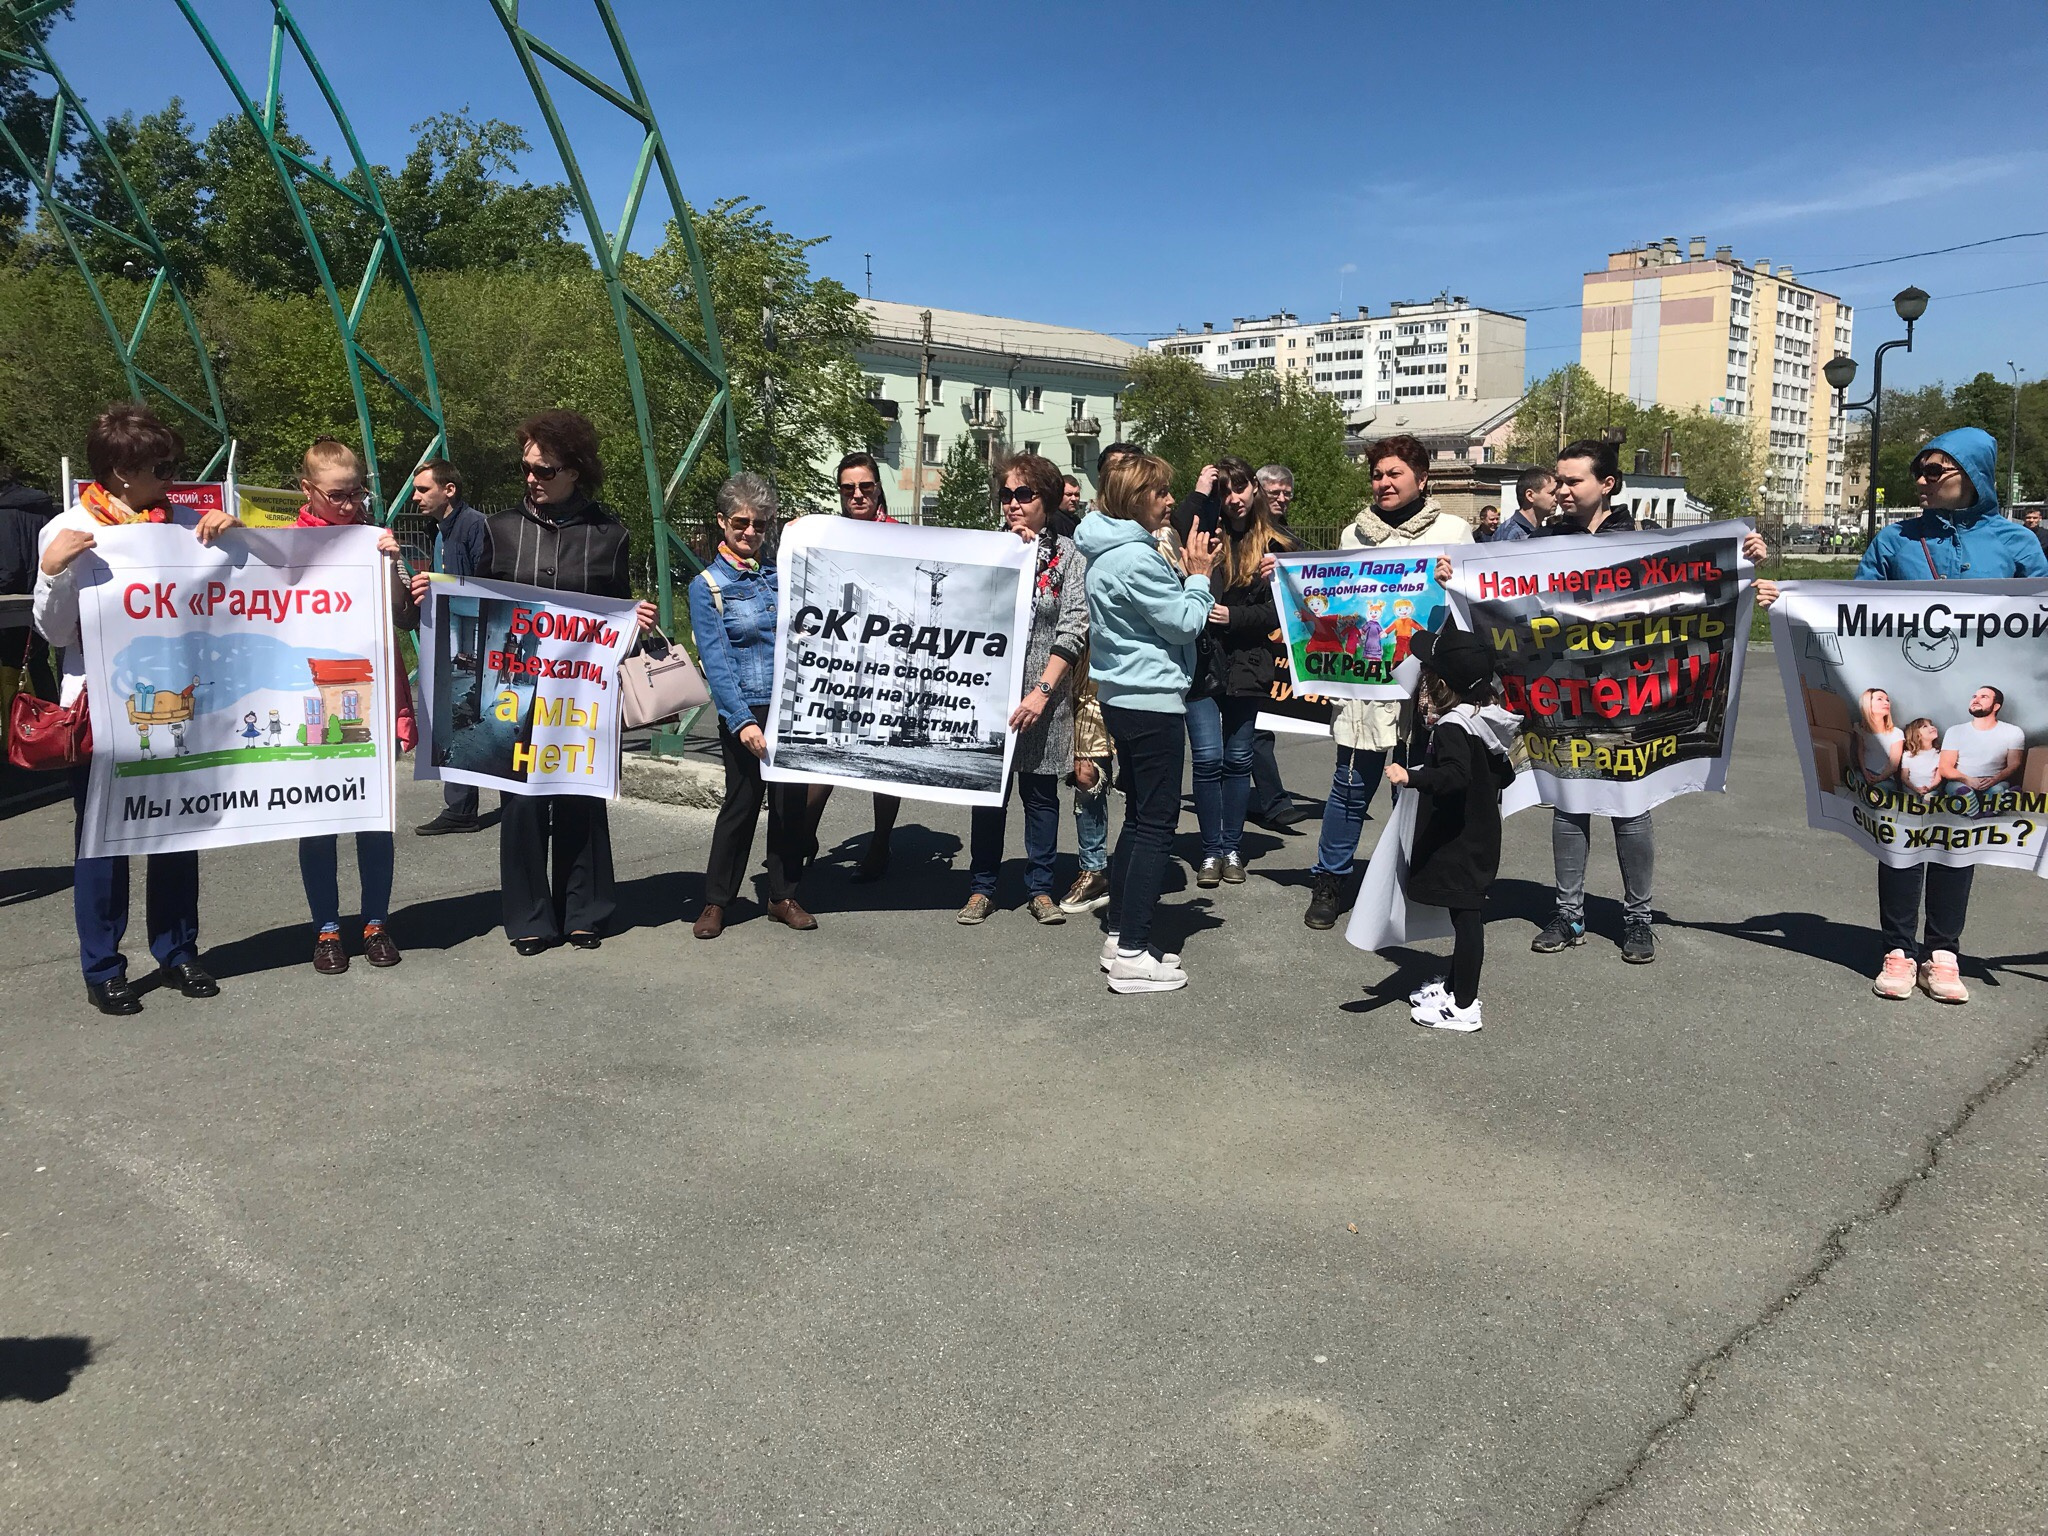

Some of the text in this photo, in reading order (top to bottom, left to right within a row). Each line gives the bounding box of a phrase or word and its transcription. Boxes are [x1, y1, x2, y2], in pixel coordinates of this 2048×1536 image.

[166, 492, 214, 504] ЕСКИЙ, 33
[251, 496, 299, 505] МИНИСТЕРСТВО
[1301, 559, 1428, 579] Мама, Папа, Я
[1479, 556, 1723, 599] Нам негде Жить
[123, 581, 353, 623] СК «Радуга»
[1303, 582, 1424, 598] бездомная семья
[511, 607, 619, 648] БОМЖи
[794, 605, 1008, 660] СК Радуга
[1491, 612, 1725, 652] и Растить
[1837, 603, 2048, 647] МинСтрой
[488, 650, 608, 690] въехали,
[801, 651, 860, 674] Воры
[864, 661, 890, 676] на
[1305, 653, 1337, 675] СК
[1341, 660, 1403, 684] Раду
[810, 677, 975, 711] Люди на улице.
[1502, 652, 1720, 720] детей!!!
[495, 690, 599, 731] а мы
[807, 701, 978, 735] Позор властям!
[512, 737, 596, 775] нет!
[1524, 732, 1677, 776] СК Радуга
[124, 777, 366, 821] Мы хотим домой!
[1845, 768, 2048, 816] Сколько нам
[1852, 805, 2036, 851] ещё ждать?
